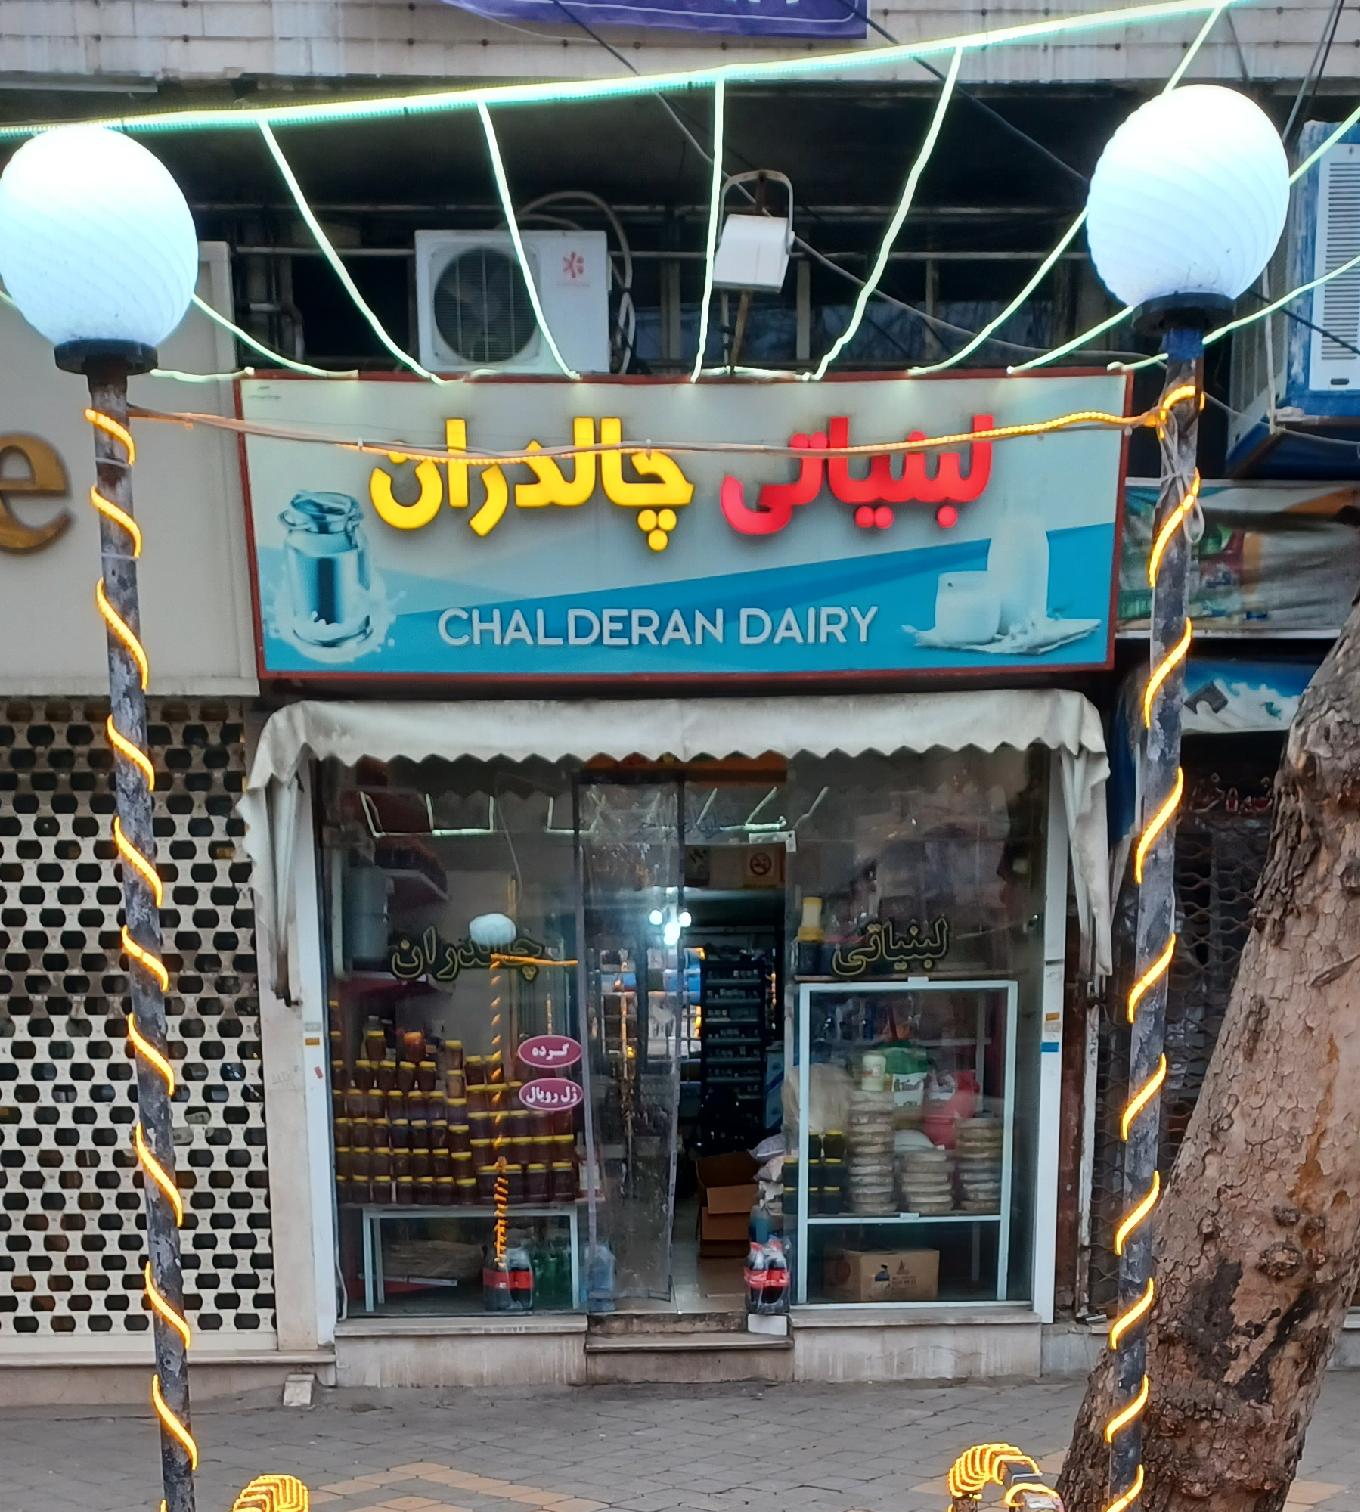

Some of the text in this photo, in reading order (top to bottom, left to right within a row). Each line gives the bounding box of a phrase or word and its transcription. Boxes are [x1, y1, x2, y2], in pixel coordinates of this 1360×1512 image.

[368, 414, 994, 552] لبنیاتی چالدران
[437, 605, 880, 647] CHALDERAN DAIRY
[832, 915, 949, 976] لبنیاتی
